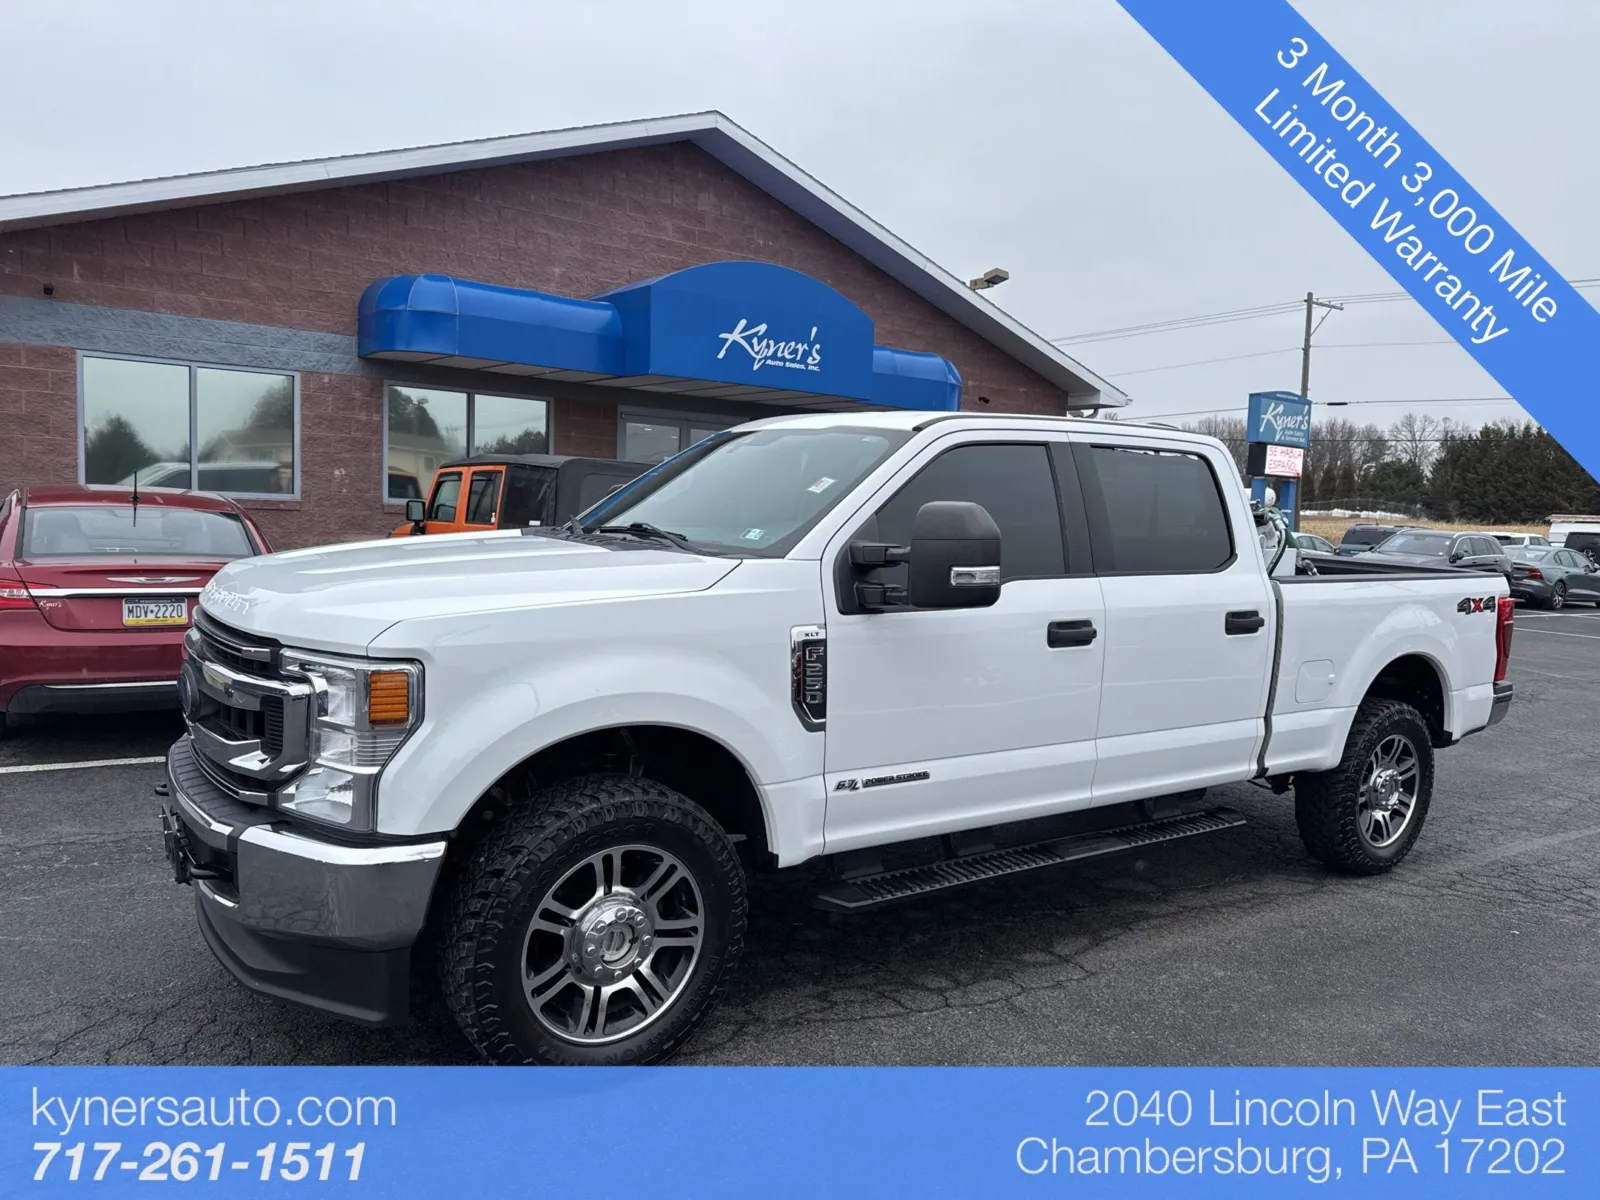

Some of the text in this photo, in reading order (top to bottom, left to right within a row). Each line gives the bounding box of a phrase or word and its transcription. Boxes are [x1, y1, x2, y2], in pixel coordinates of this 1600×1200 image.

[717, 318, 821, 371] Kyner's
[765, 359, 784, 367] Auto
[785, 361, 807, 370] Sales,
[1260, 402, 1309, 442] Kyner's
[1268, 447, 1302, 459] SE HABLA
[864, 770, 929, 785] POWER STROKE
